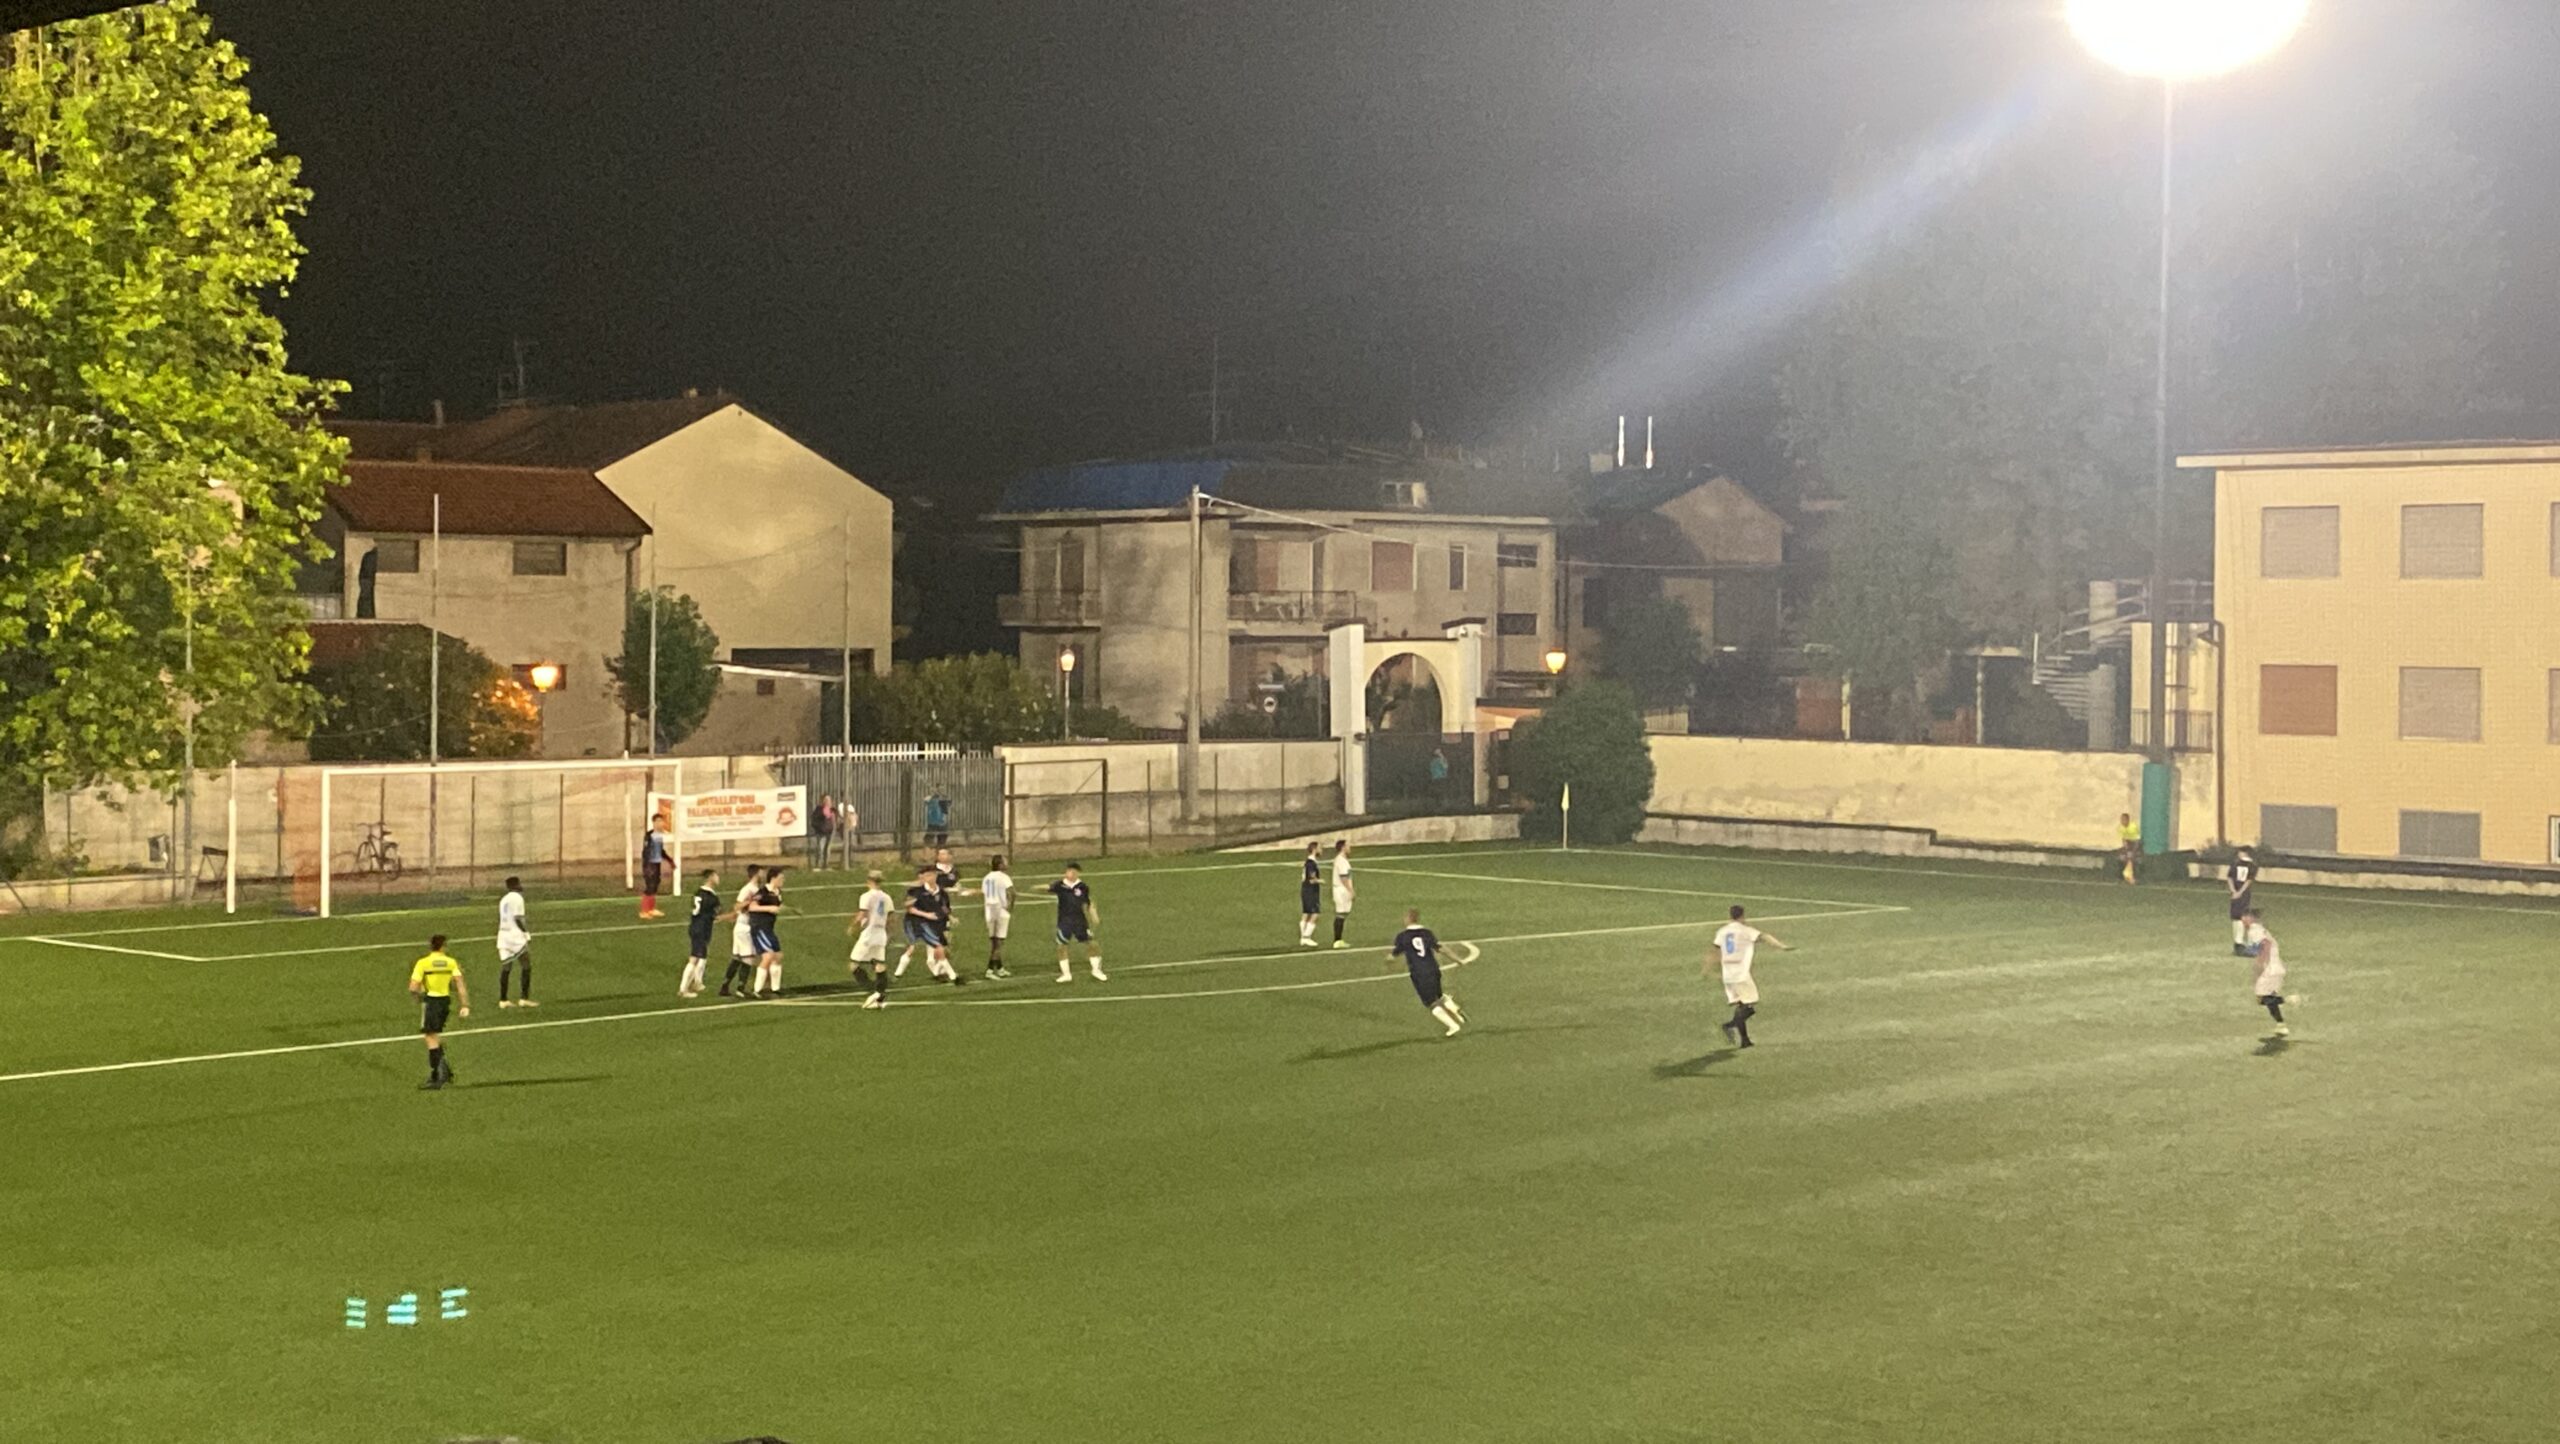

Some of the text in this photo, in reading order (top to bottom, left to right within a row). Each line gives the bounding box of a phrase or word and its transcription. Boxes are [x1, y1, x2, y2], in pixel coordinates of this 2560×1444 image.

[692, 896, 702, 916] 5
[1411, 936, 1426, 957] 9
[1725, 932, 1735, 954] 6
